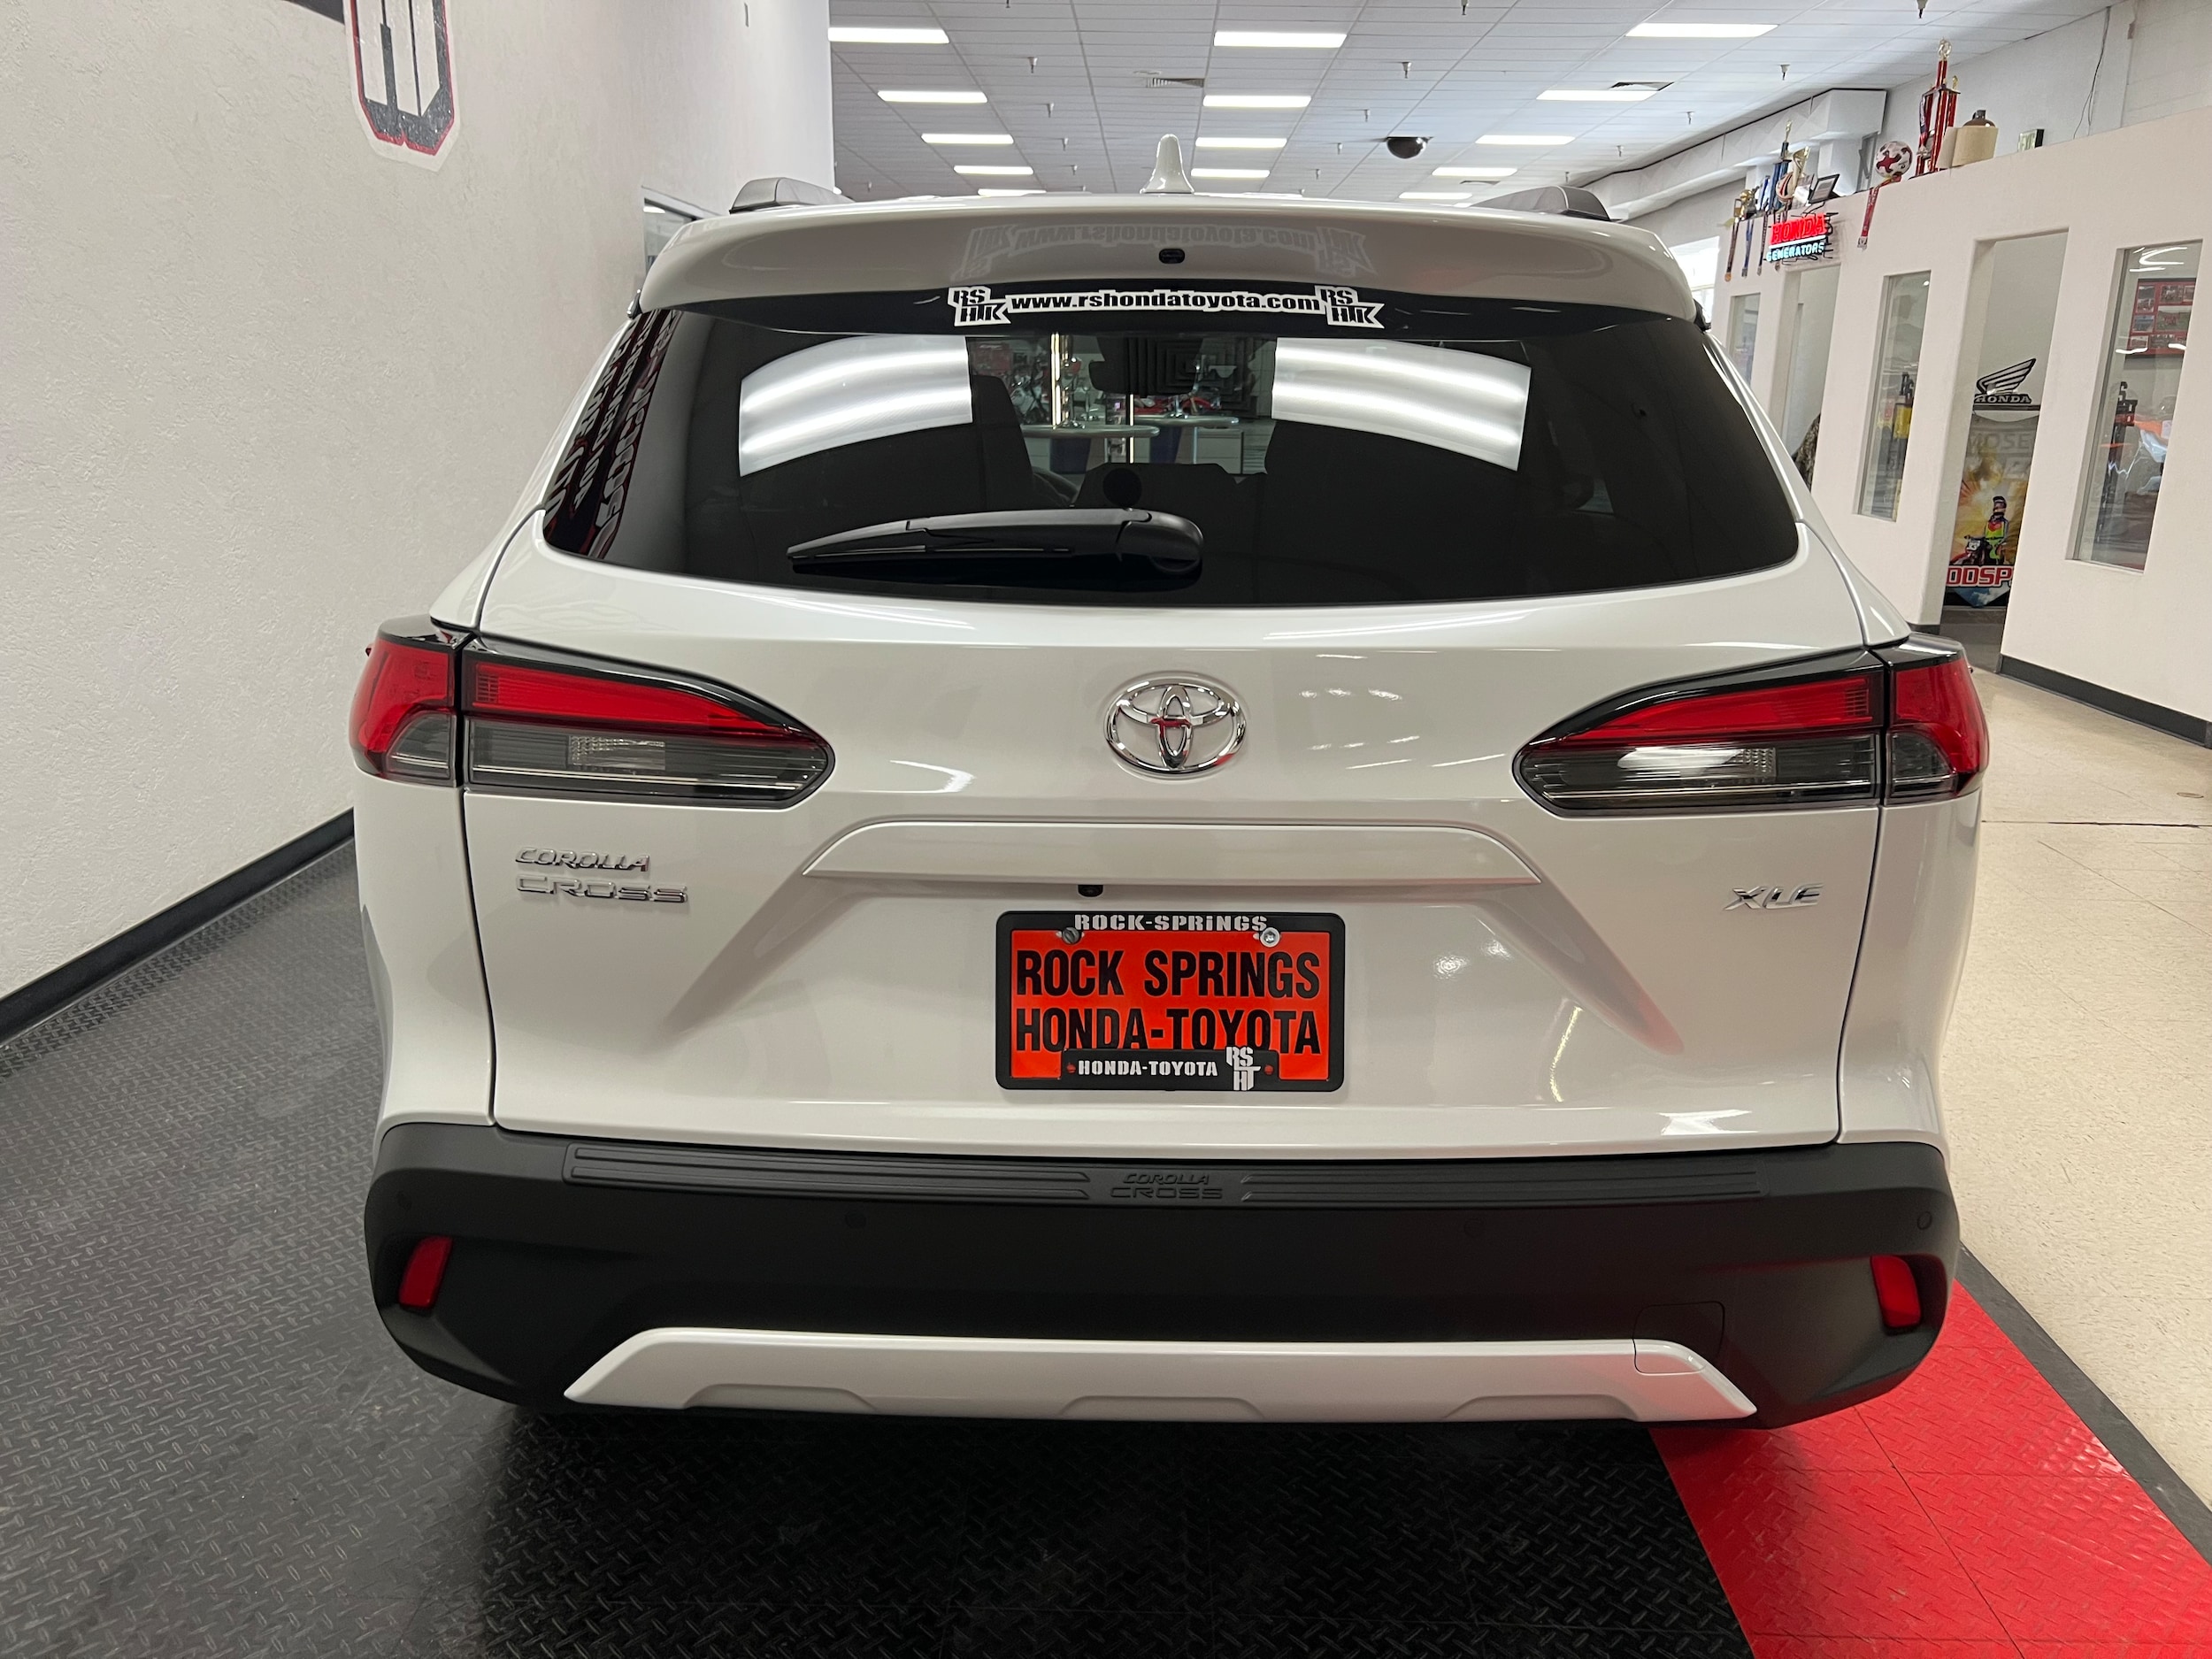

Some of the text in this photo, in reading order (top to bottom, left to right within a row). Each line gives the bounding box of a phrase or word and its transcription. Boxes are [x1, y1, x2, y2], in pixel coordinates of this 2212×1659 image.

[1770, 212, 1828, 245] HONDA
[1766, 242, 1824, 262] GENERATORS
[953, 288, 987, 305] RS
[1010, 290, 1321, 311] www.rshondatoyota.com
[1319, 288, 1354, 306] RS
[1974, 393, 2032, 404] HONDA
[515, 847, 650, 872] COROLLA
[517, 875, 688, 902] CROSS
[1724, 883, 1824, 910] XLE
[1074, 914, 1268, 932] ROCK-SPRINGS
[1016, 949, 1321, 999] ROCK SPRINGS
[1015, 1008, 1322, 1055] HONDA-TOYOTA
[1078, 1060, 1218, 1077] HONDA-TOYOTA
[1123, 1173, 1210, 1185] COROLLA
[1110, 1187, 1223, 1200] CROSS
